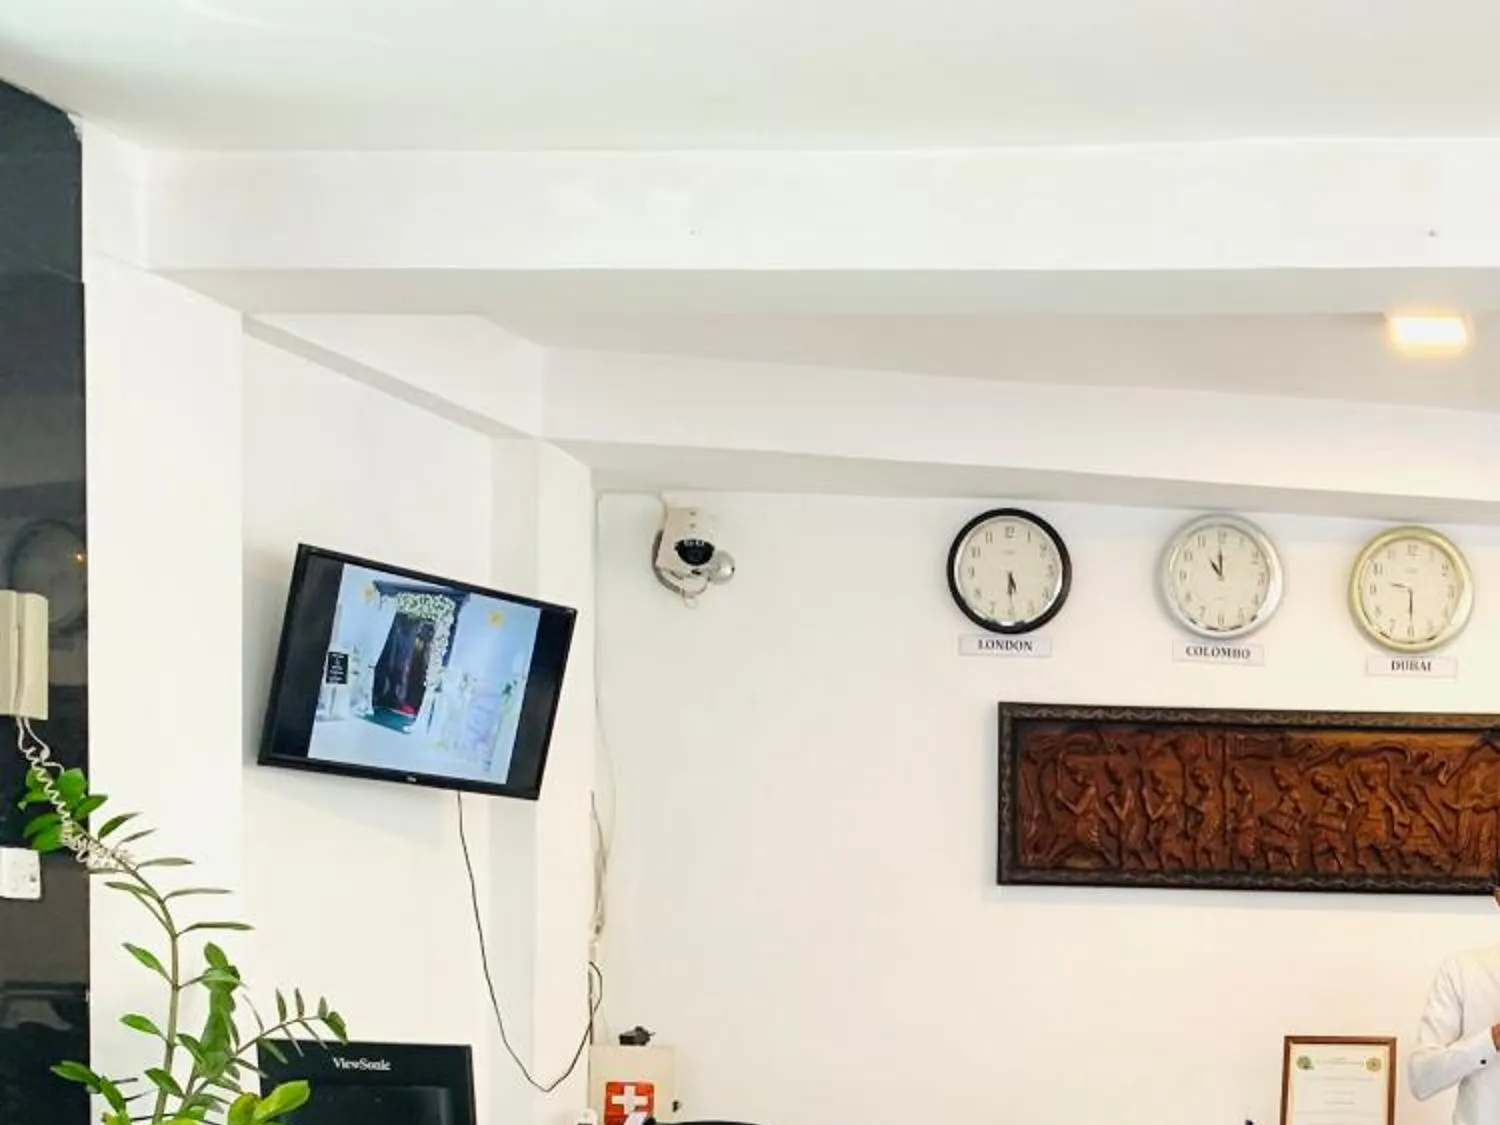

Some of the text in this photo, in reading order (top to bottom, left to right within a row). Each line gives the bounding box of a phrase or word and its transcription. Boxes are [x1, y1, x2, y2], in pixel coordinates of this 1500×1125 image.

[978, 639, 1033, 651] LONDON
[1185, 646, 1251, 659] COLOMBO
[1391, 660, 1431, 672] DUBAI
[332, 1057, 392, 1071] ViewSonic
